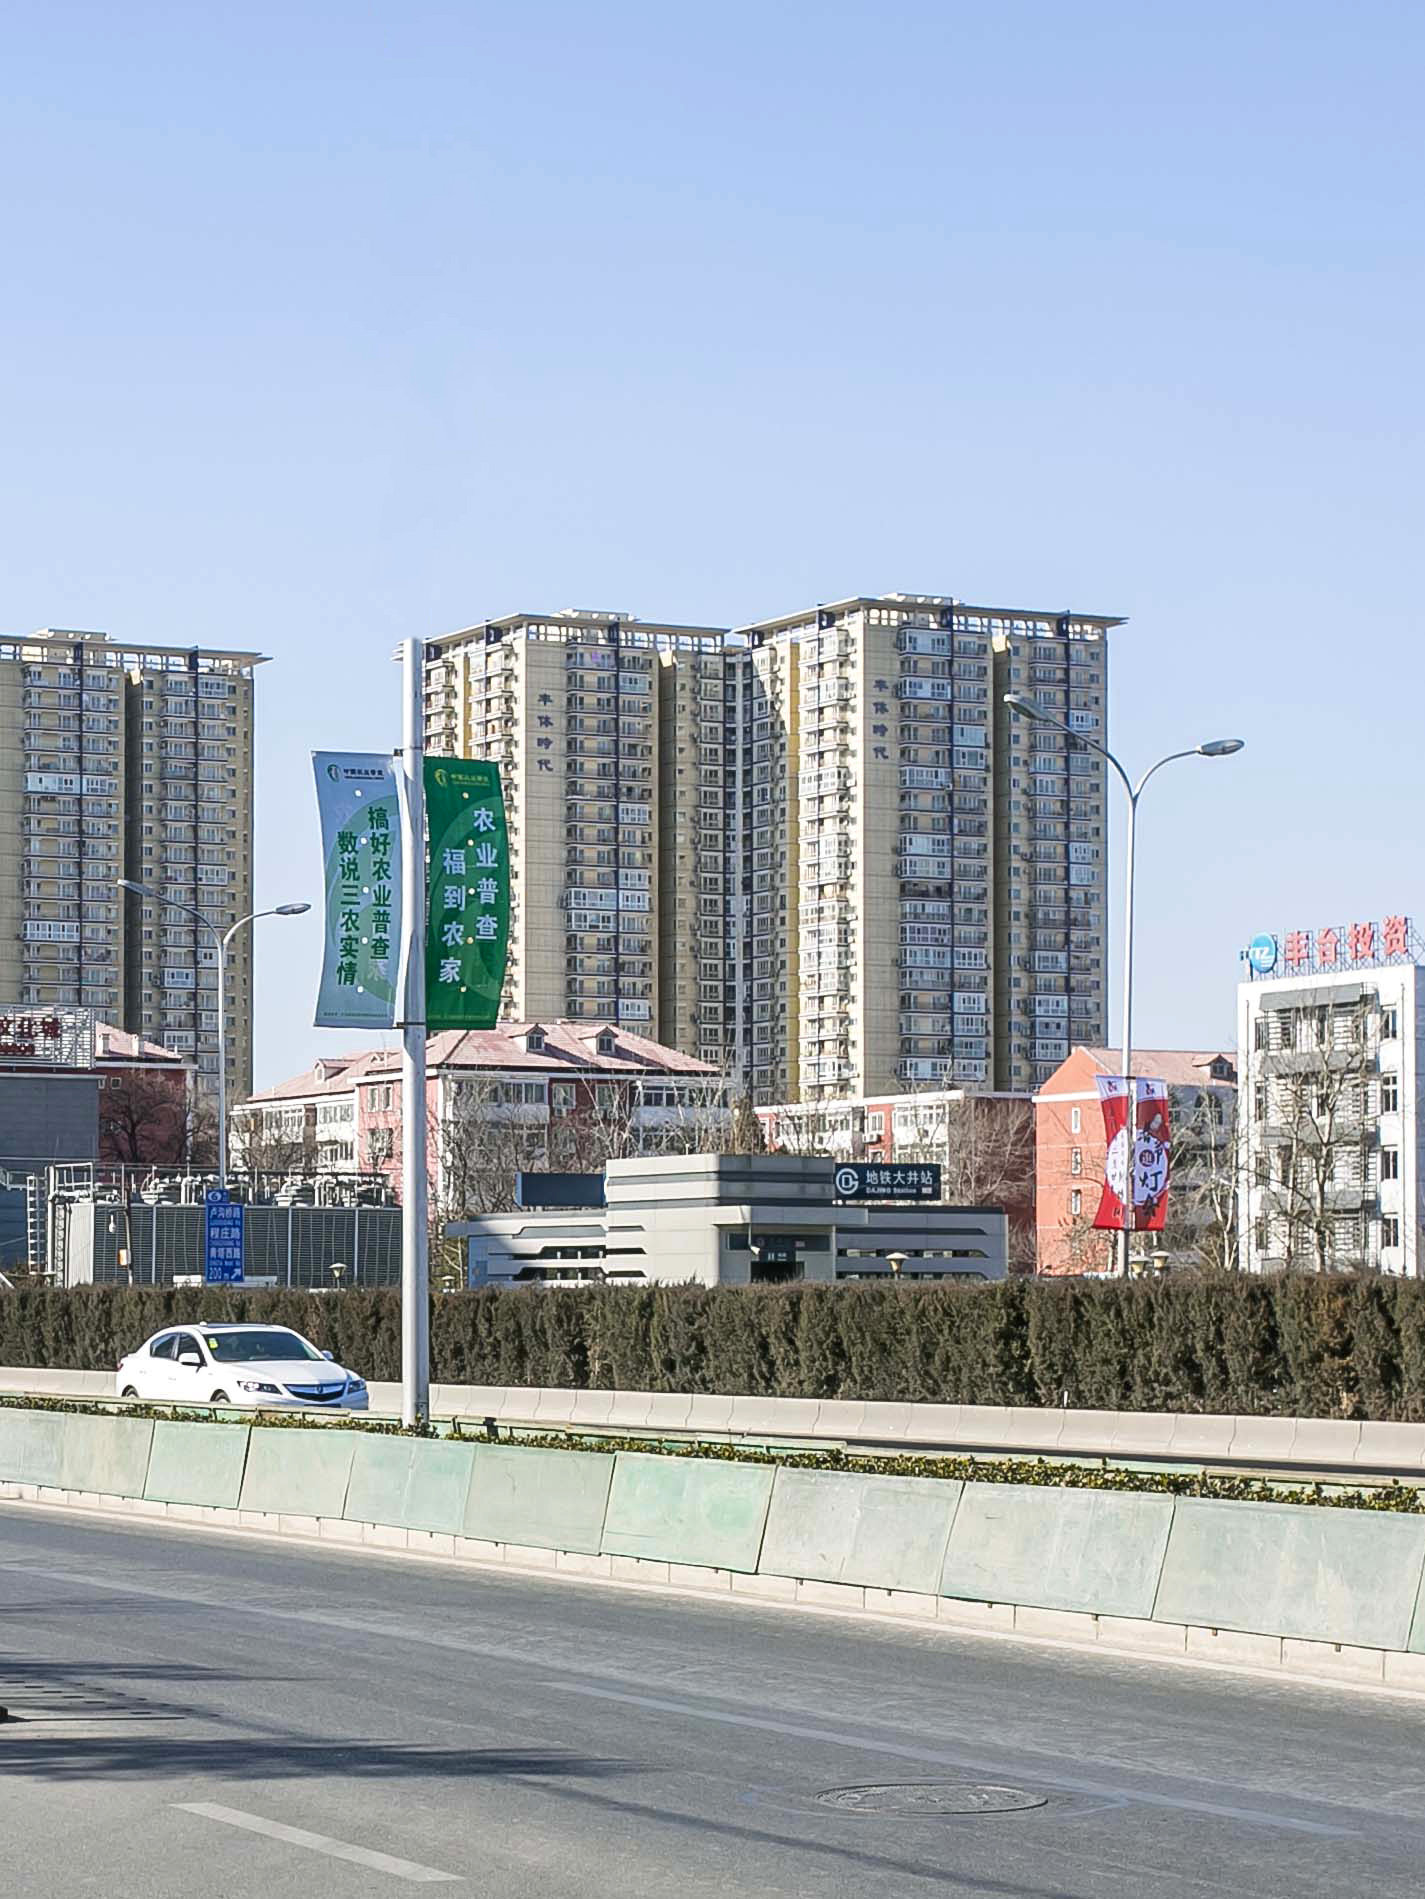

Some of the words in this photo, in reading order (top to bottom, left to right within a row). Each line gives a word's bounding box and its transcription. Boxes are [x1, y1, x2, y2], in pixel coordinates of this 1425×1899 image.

[336, 831, 361, 986] 数说三农实情
[368, 806, 393, 961] 搞好农业普查
[438, 848, 467, 984] 福到农家
[473, 807, 499, 941] 农业普查
[1285, 914, 1409, 967] 丰台投资
[865, 1169, 934, 1185] 地铁大井站
